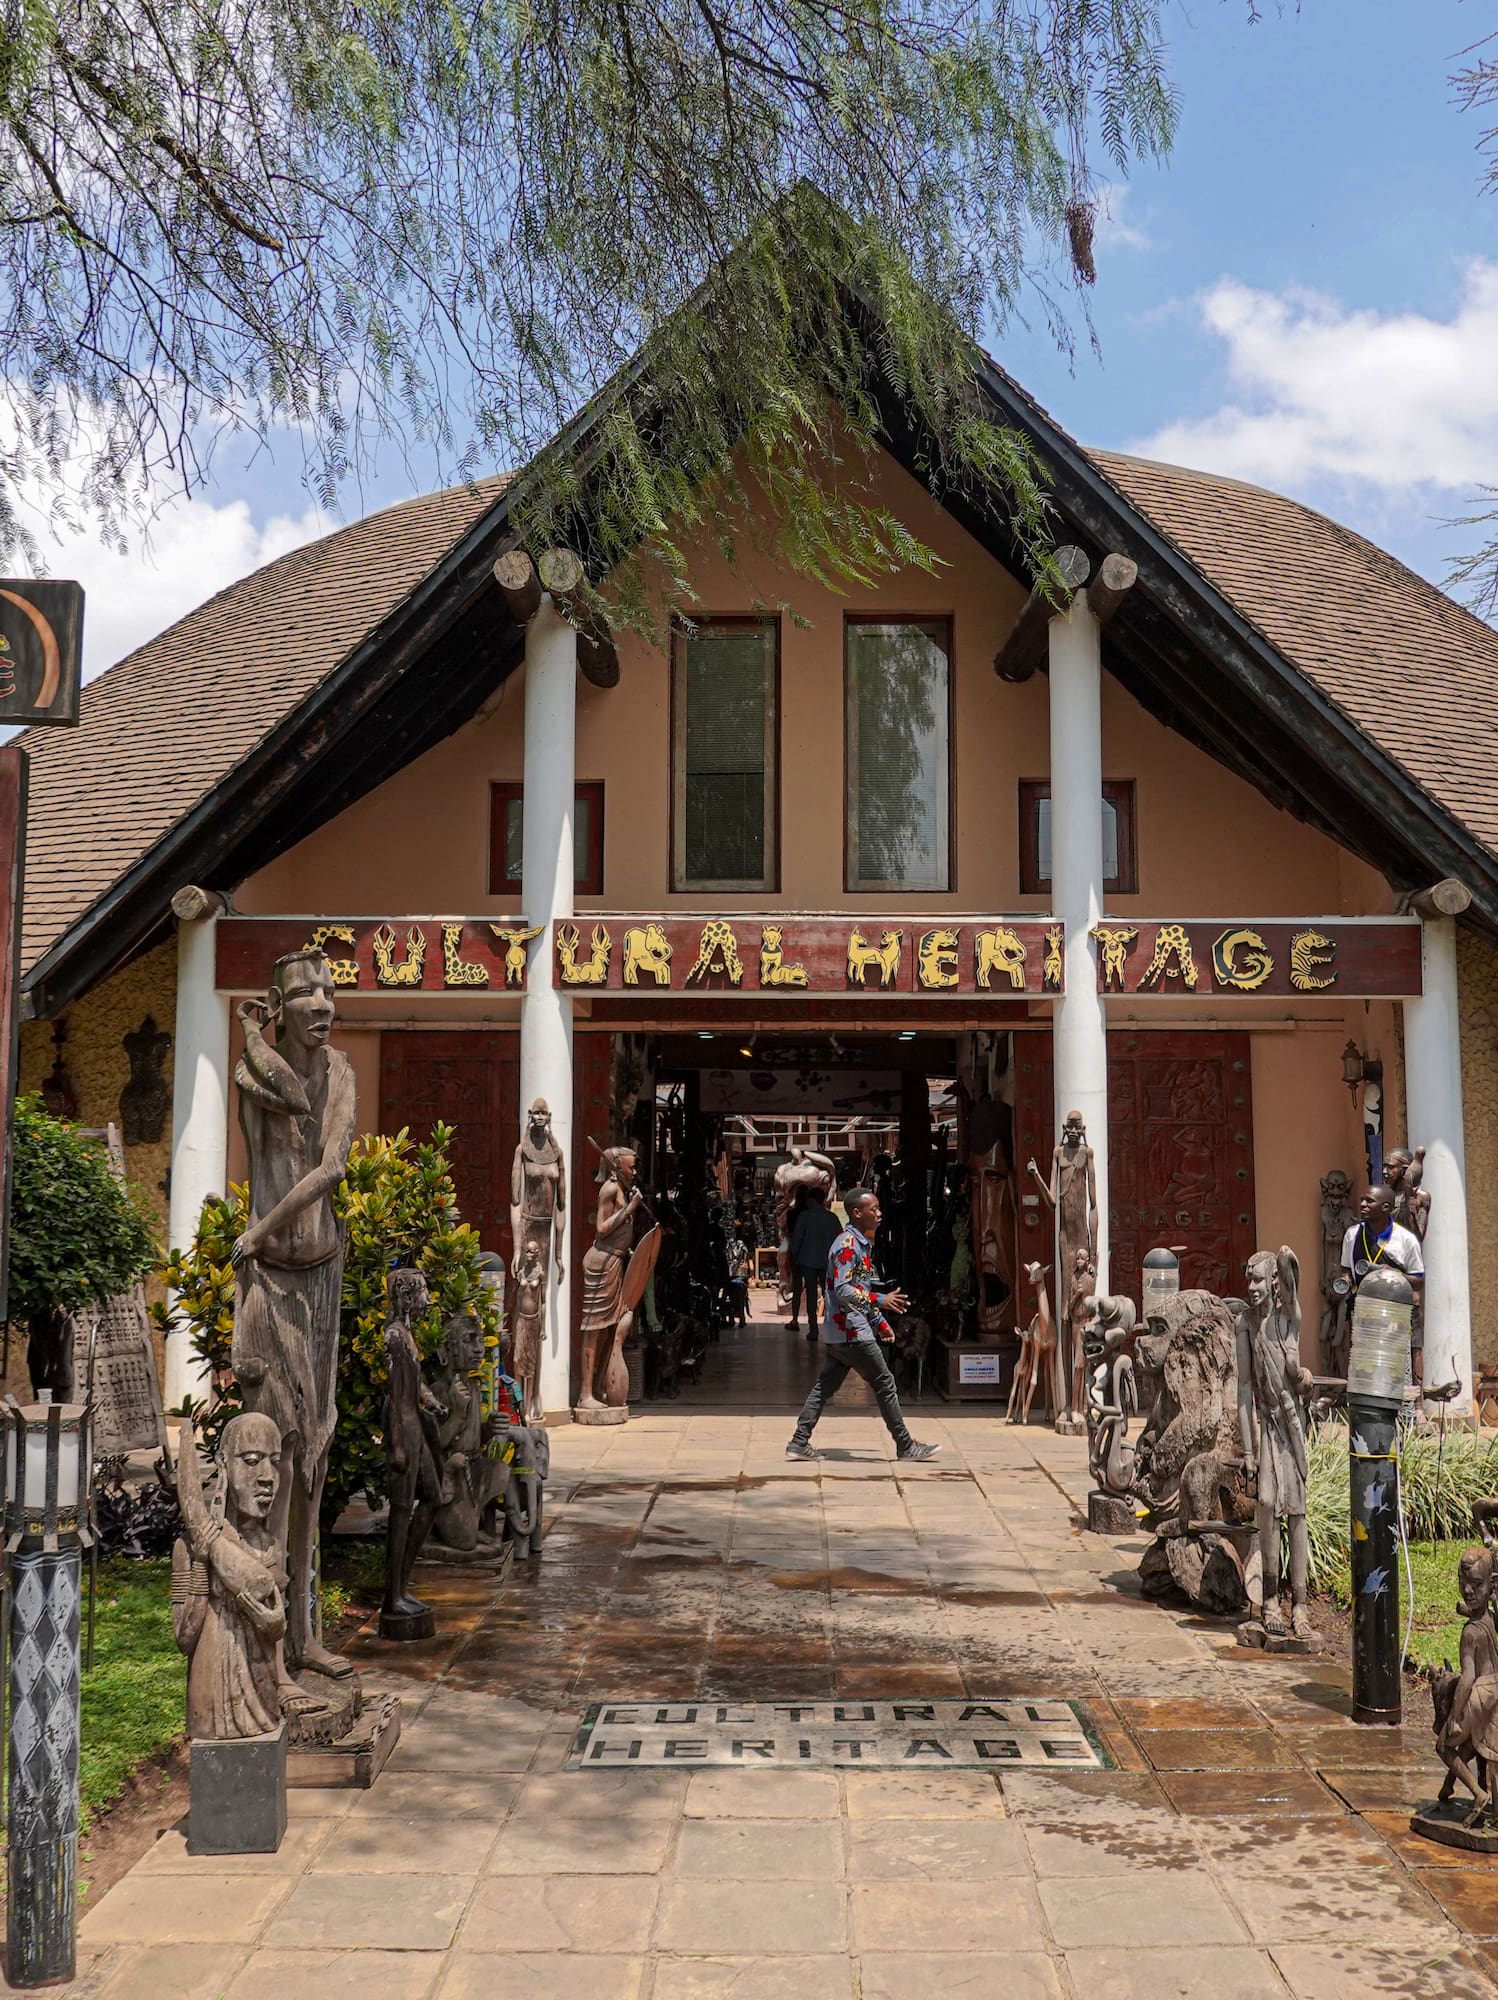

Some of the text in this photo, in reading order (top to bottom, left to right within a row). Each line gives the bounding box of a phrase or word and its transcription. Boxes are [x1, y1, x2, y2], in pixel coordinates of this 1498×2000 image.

[303, 922, 1338, 991] CULTURAL HERITAGE
[601, 1704, 1072, 1725] CULTURAL
[589, 1738, 1094, 1761] HERITAGE
